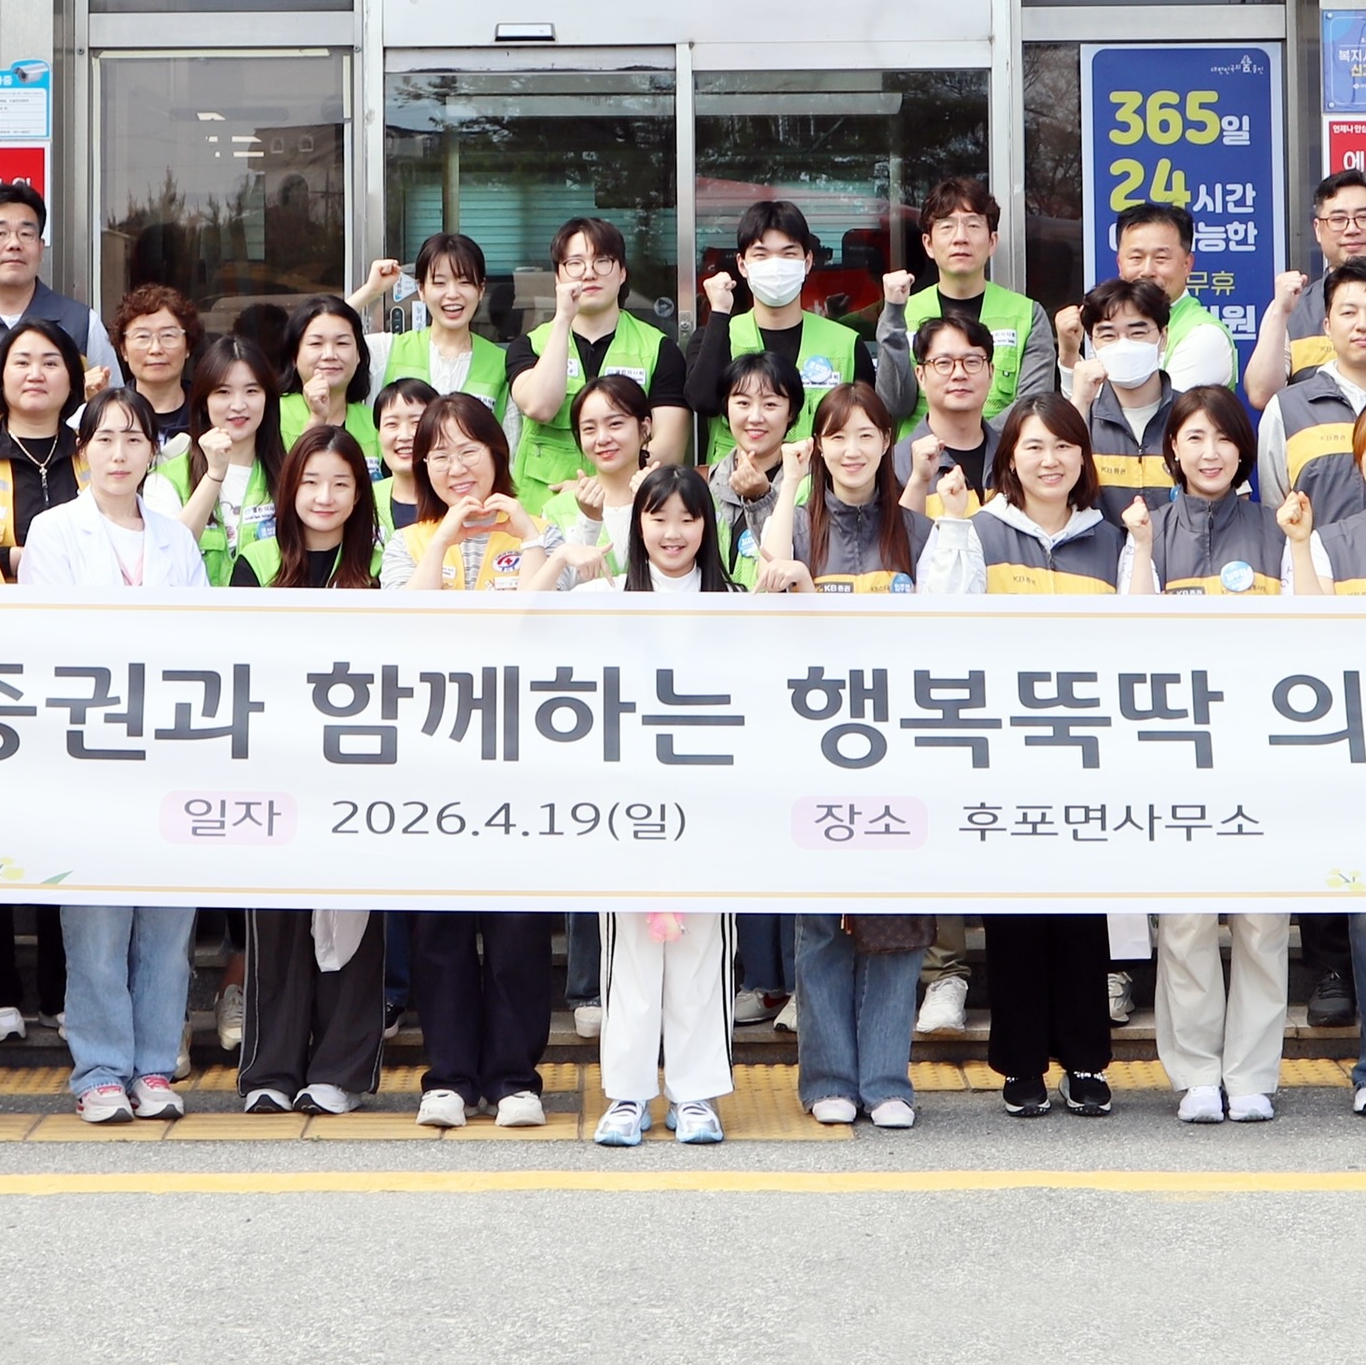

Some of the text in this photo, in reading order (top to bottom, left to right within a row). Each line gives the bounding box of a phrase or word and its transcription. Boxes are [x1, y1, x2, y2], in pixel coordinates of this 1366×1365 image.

[1108, 89, 1252, 146] 365일
[1332, 124, 1353, 133] 언제나
[1109, 157, 1257, 214] 24시간
[1192, 220, 1259, 252] 능한
[824, 583, 851, 592] KB증권
[306, 660, 746, 766] 함께하는
[787, 664, 1225, 770] 행복뚝딱
[182, 797, 688, 843] 일자 2026.4.19(일)
[814, 801, 1265, 844] 장소 후포면사무소
